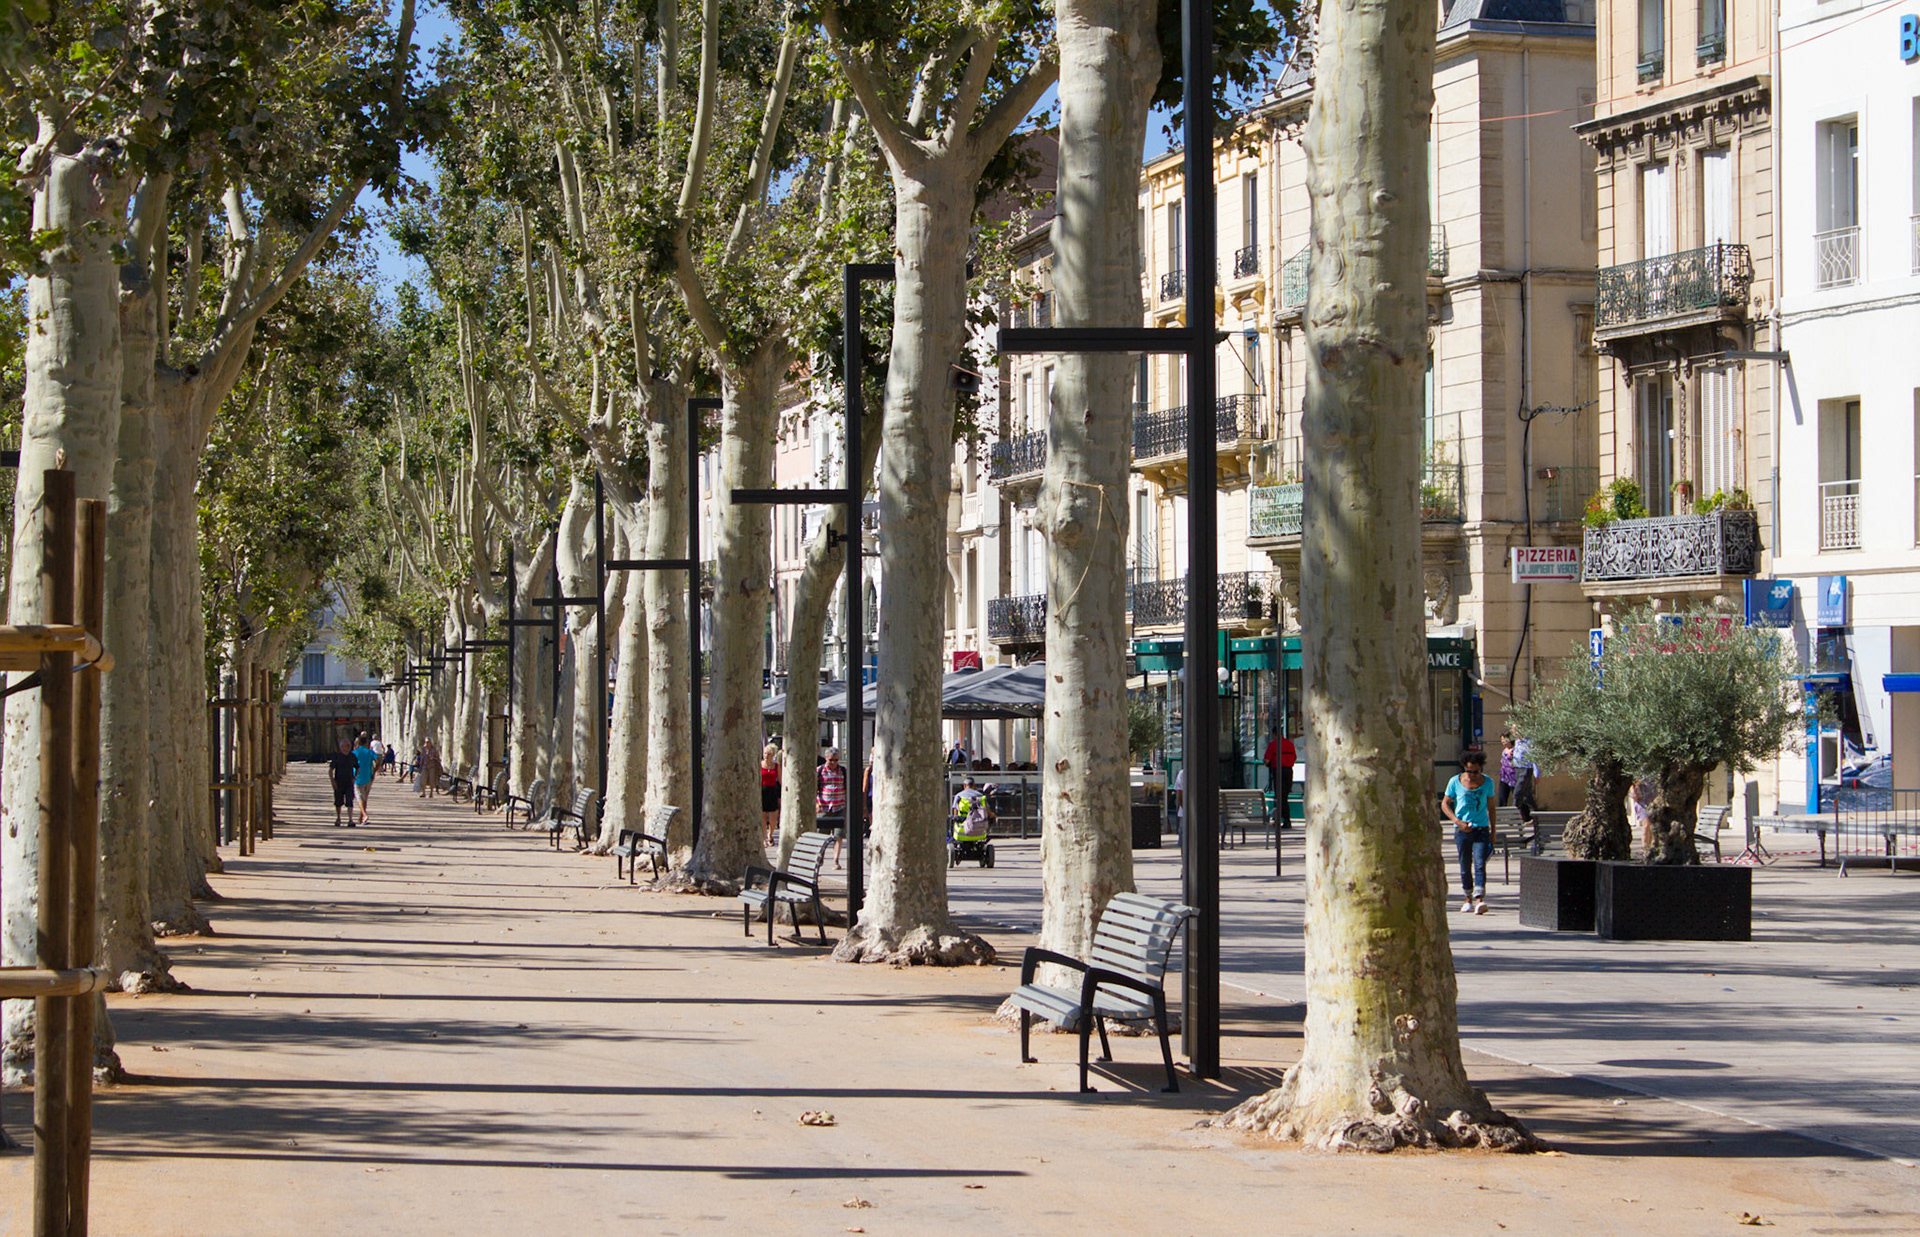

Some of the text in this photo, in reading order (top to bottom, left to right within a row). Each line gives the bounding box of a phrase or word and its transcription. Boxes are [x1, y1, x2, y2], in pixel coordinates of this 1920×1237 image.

[1900, 14, 1920, 60] B
[1517, 549, 1577, 562] PIZZERIA
[1517, 564, 1526, 574] LA
[1557, 564, 1578, 574] VERTE
[310, 694, 374, 703] Brasserie
